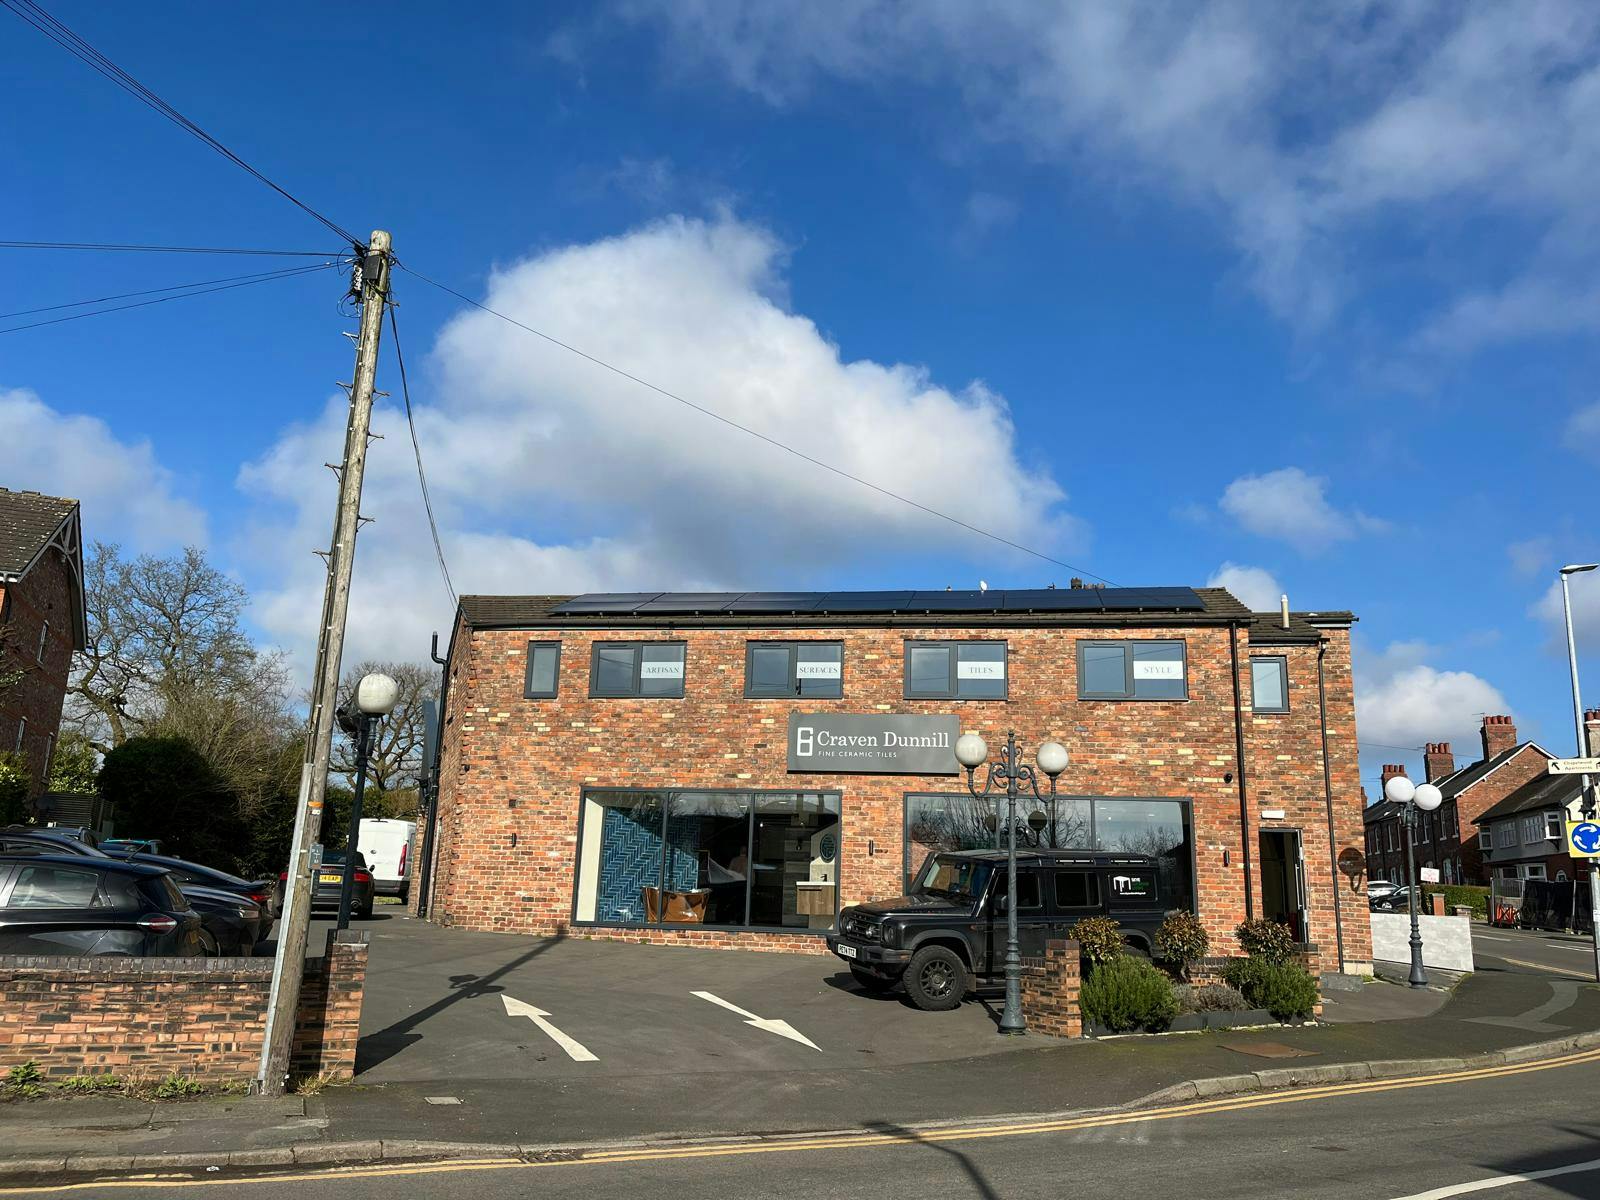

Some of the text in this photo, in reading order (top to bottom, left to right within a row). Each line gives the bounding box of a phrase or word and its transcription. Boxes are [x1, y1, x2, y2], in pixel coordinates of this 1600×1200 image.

[645, 666, 680, 674] ARTISAN
[799, 666, 838, 674] SURFACES
[968, 666, 994, 674] TILES
[1143, 665, 1172, 674] STYLE
[817, 730, 949, 748] Craven Dunnill
